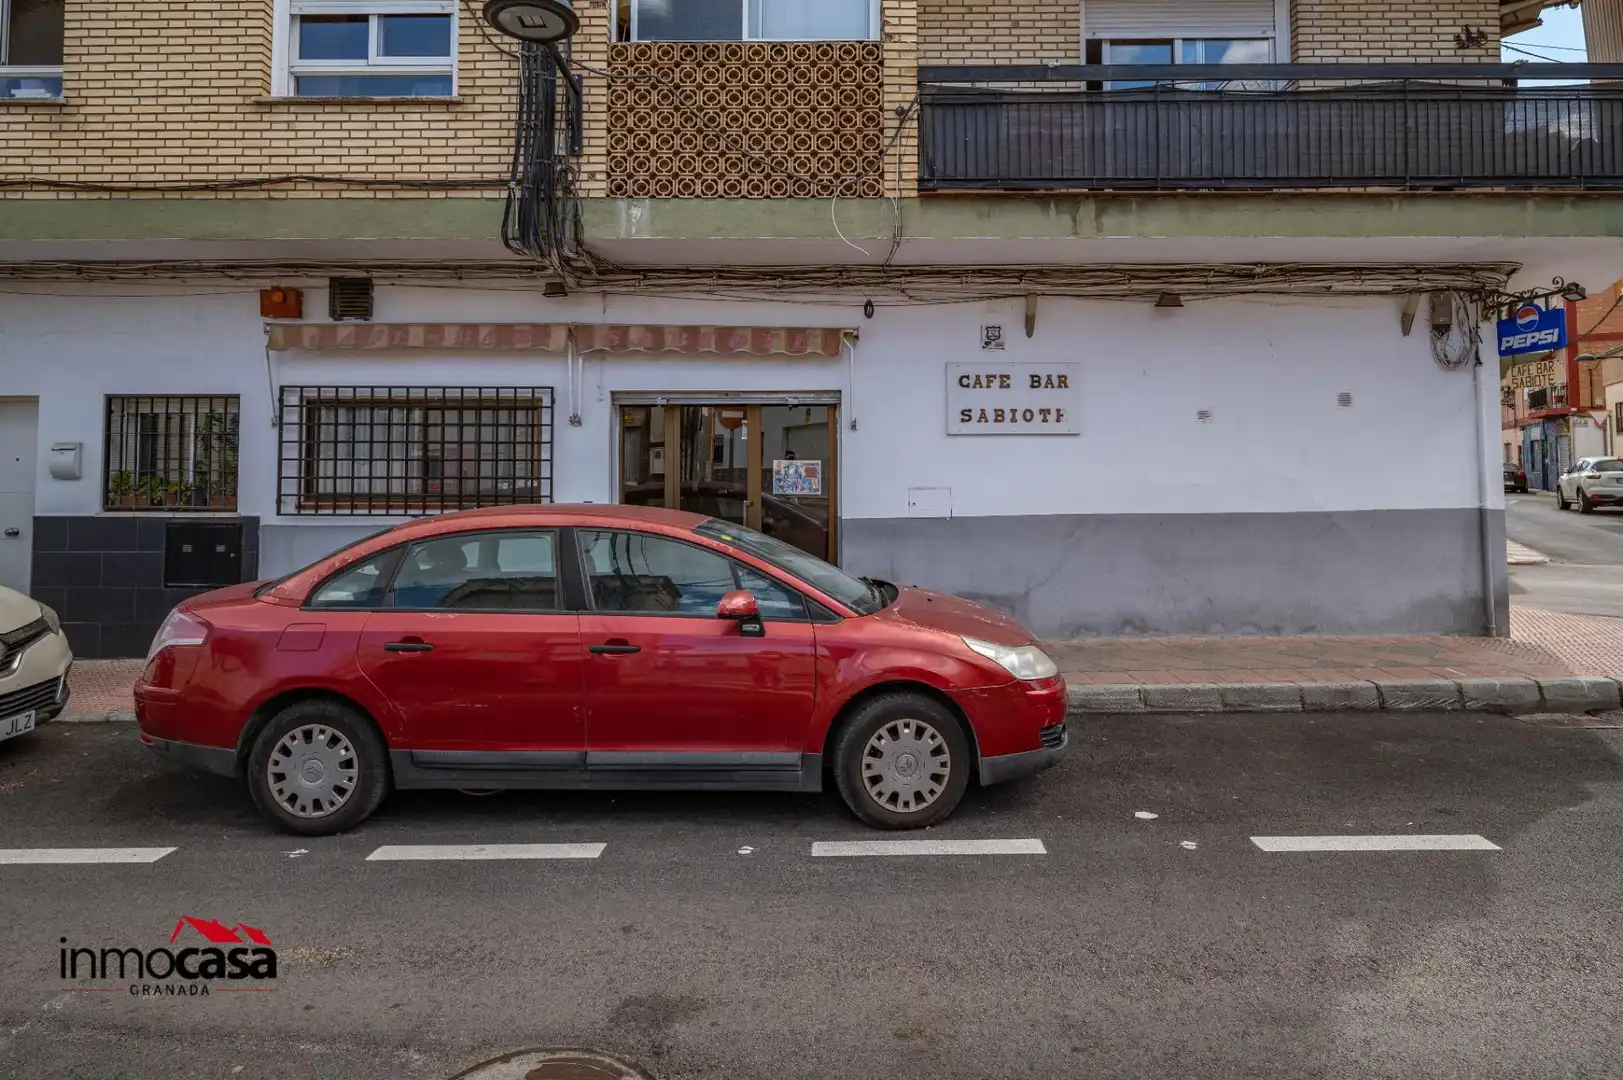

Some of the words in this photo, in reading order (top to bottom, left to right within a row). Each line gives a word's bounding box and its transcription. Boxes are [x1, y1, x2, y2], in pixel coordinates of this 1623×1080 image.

[1501, 328, 1560, 350] PEPSI
[1511, 363, 1533, 378] CAFE
[1536, 360, 1555, 374] BAR
[958, 374, 1011, 389] CAFE
[1029, 374, 1069, 389] BAR
[1511, 373, 1555, 389] SABIOTE
[5, 713, 33, 736] JLZ
